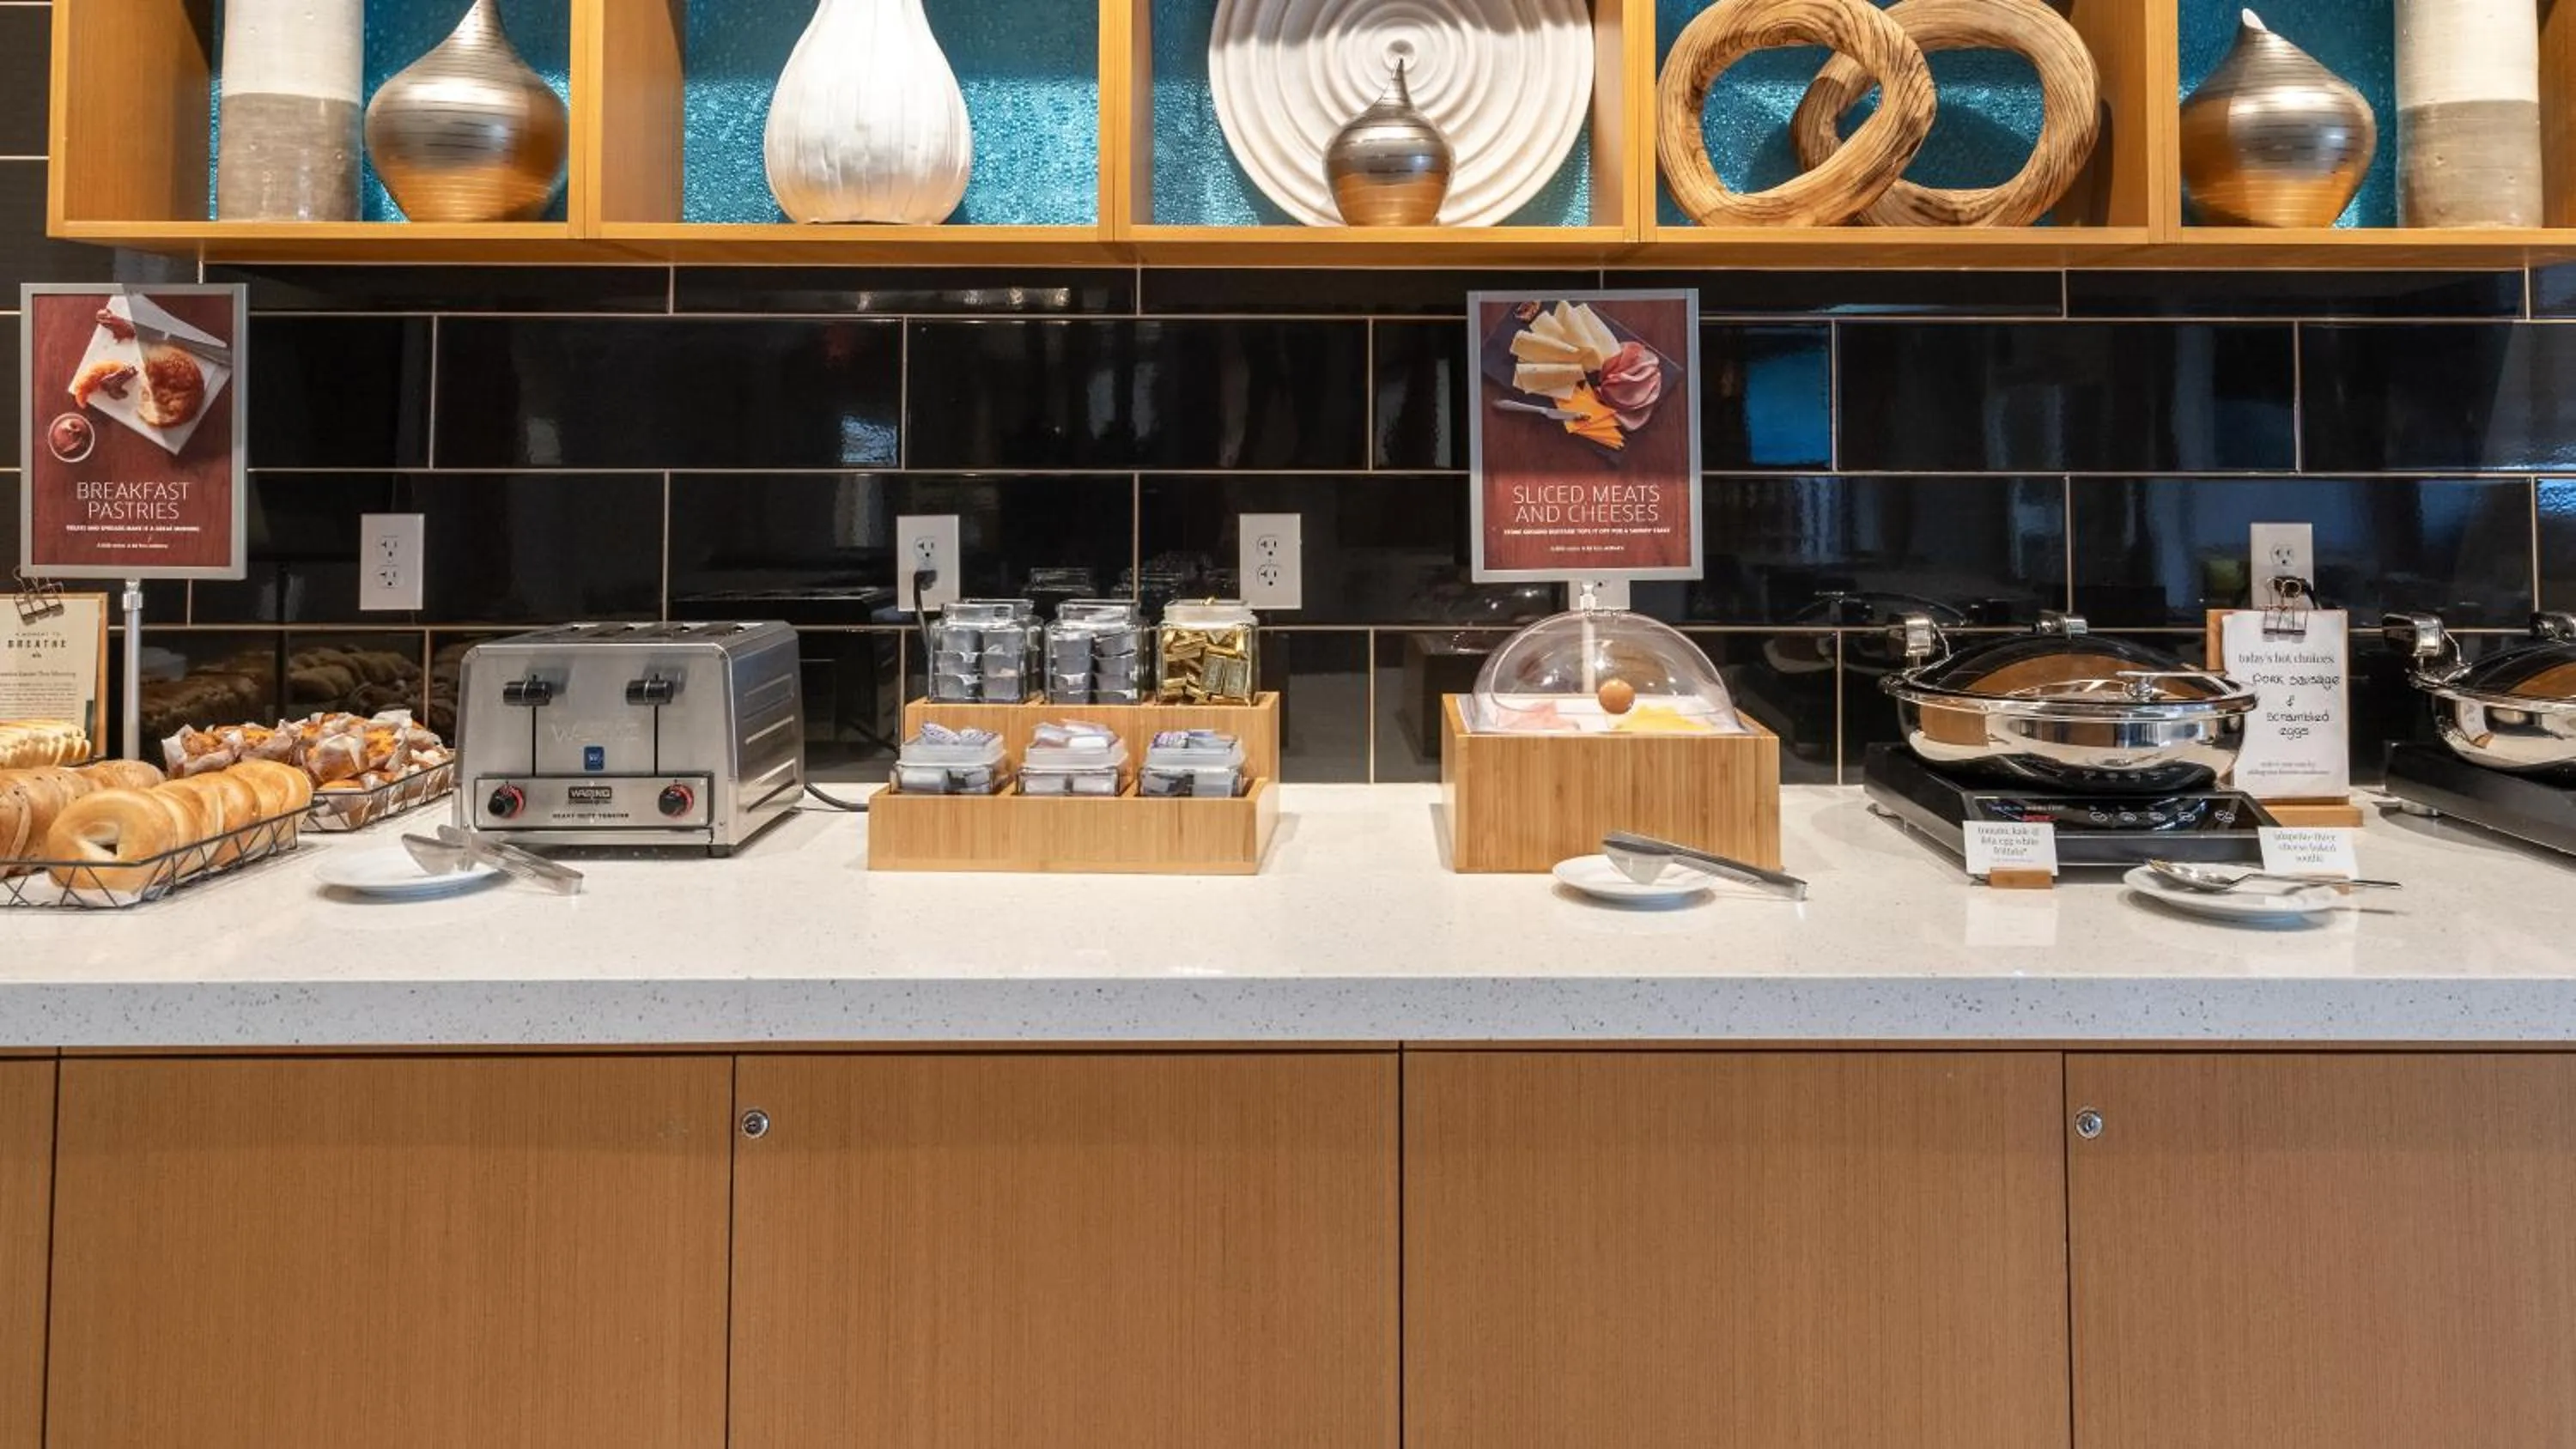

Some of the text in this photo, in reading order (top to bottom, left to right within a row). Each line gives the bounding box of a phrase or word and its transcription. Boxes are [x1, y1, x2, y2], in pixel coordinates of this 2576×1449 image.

[76, 482, 190, 500] BREAKFAST
[1513, 484, 1660, 504] SLICED MEATS
[88, 501, 179, 519] PASTRIES
[1515, 504, 1659, 523] AND CHEESES
[8, 640, 66, 648] BREATHE
[2239, 652, 2273, 665] today's
[2293, 652, 2335, 664] choices
